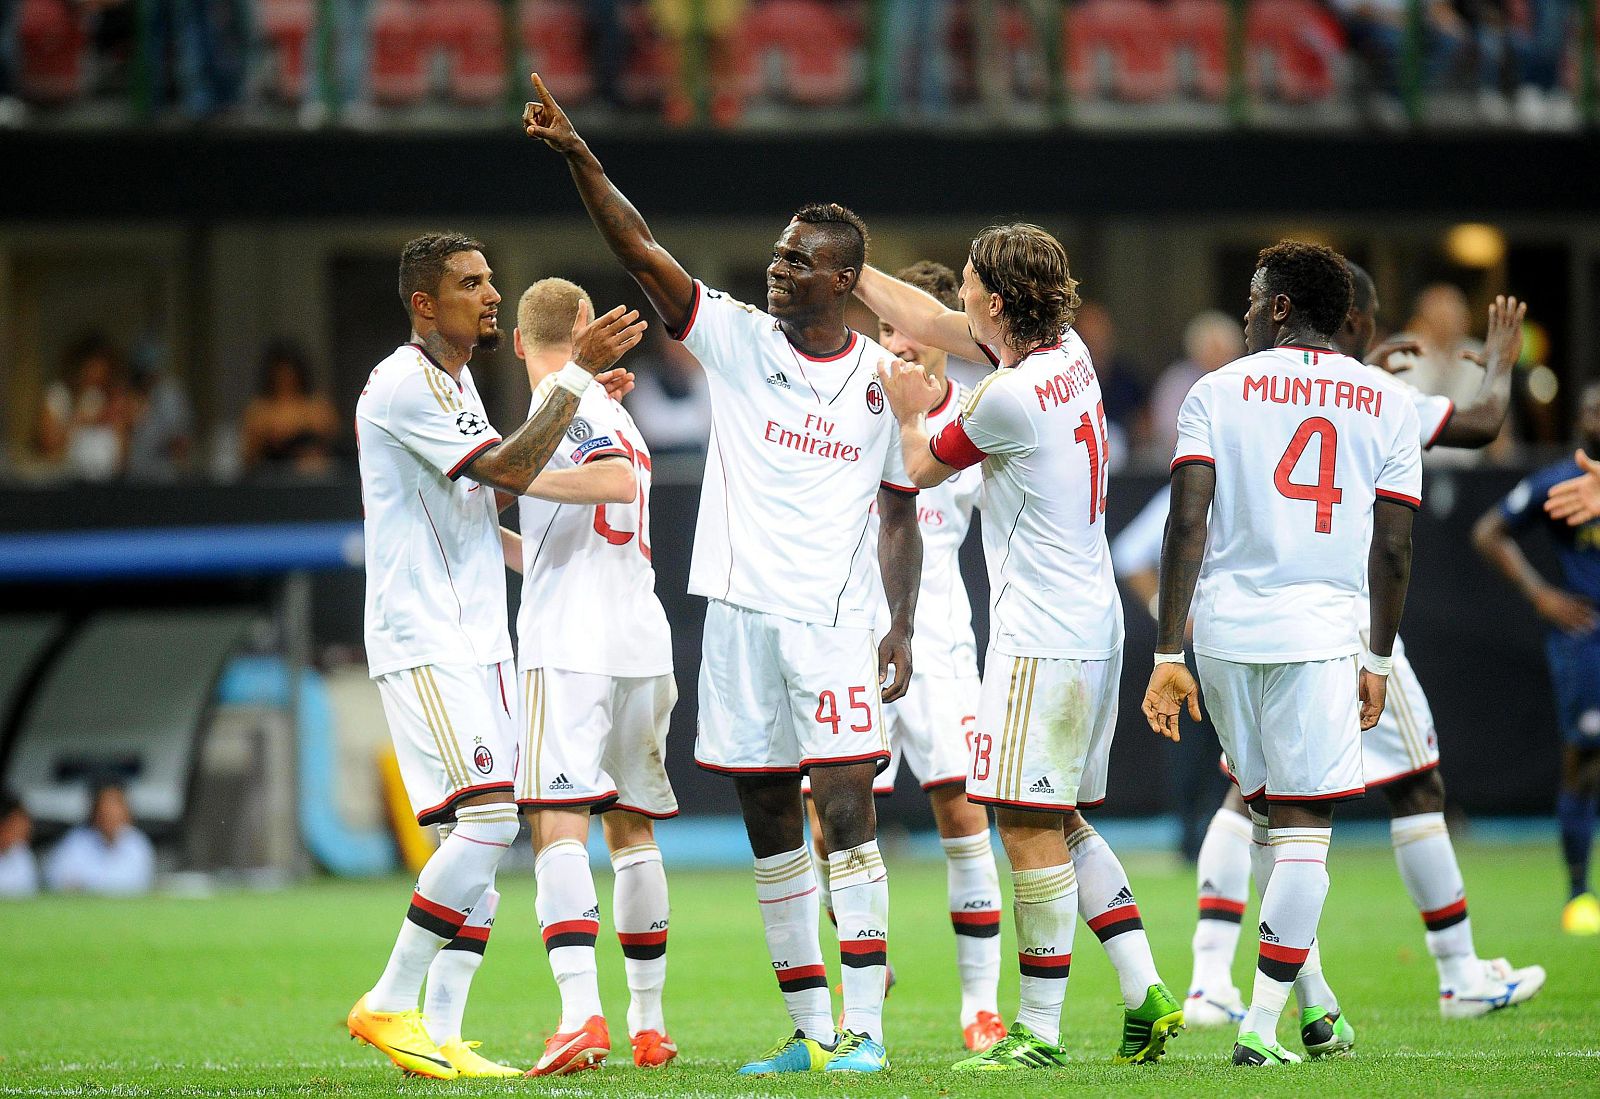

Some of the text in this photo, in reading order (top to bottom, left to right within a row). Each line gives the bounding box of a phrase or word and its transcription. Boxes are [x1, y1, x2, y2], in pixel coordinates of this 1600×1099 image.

[1034, 355, 1094, 412] MONTOL
[1243, 374, 1382, 418] MUNTARI
[804, 413, 835, 437] Fly
[579, 437, 612, 453] RESPECT
[764, 420, 862, 462] Emirates
[1273, 416, 1343, 534] 4
[815, 685, 872, 735] 45
[973, 732, 993, 781] 13
[1029, 785, 1055, 794] adidas
[963, 899, 992, 909] ACM
[857, 929, 886, 939] ACM
[1025, 946, 1055, 955] ACM
[771, 960, 790, 969] CM
